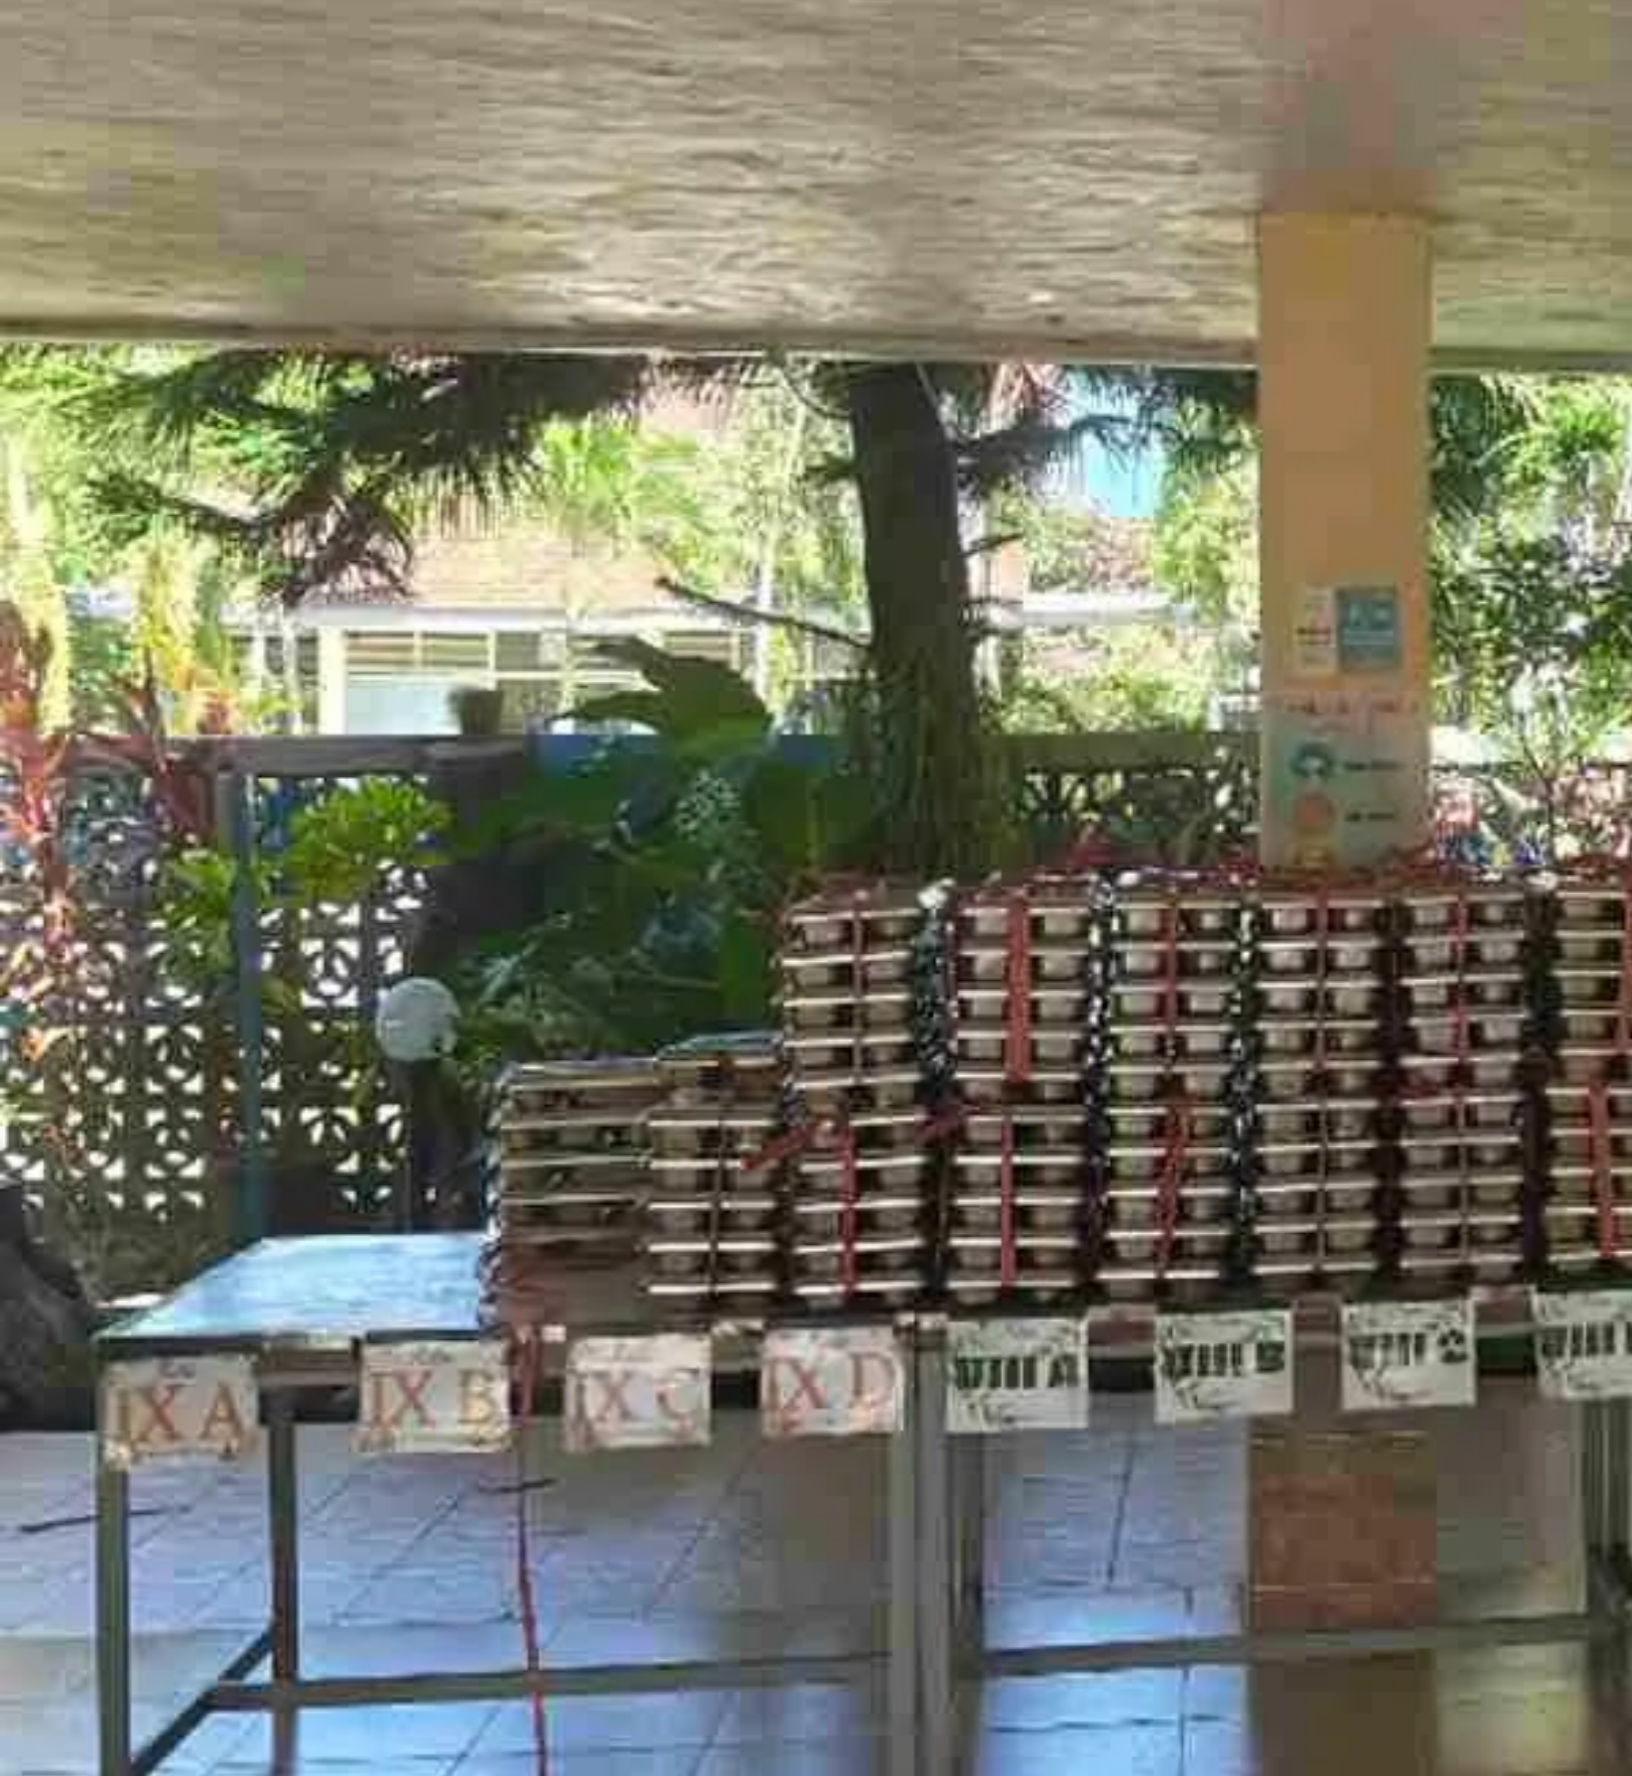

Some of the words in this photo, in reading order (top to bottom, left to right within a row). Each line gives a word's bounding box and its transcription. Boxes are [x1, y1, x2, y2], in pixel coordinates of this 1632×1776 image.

[364, 1365, 436, 1428] IX
[456, 1366, 498, 1426] B
[567, 1370, 634, 1428] IX
[764, 1355, 828, 1412] IX
[850, 1352, 899, 1400] D
[110, 1384, 180, 1445] IX
[200, 1382, 245, 1442] A
